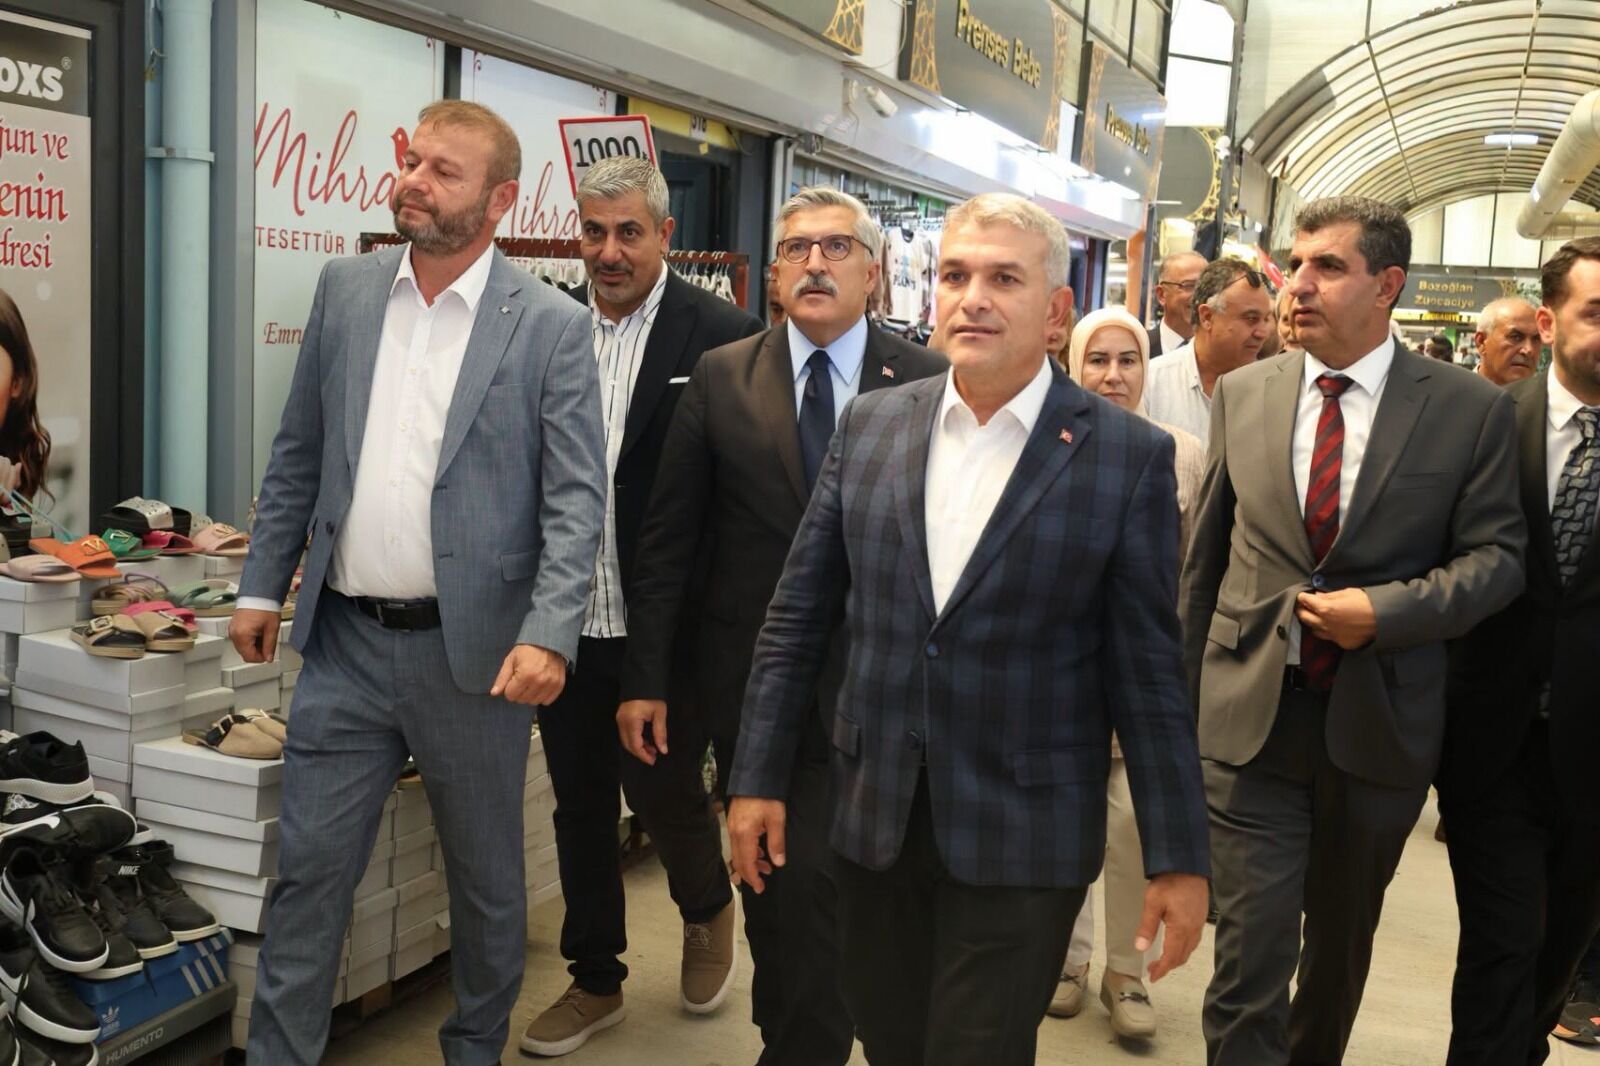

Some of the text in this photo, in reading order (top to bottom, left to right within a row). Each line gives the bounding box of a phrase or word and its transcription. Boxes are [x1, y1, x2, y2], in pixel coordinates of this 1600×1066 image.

[955, 0, 1041, 89] Prenses Bebe
[42, 133, 68, 160] ve
[255, 227, 345, 255] TESETTÜR
[118, 865, 141, 875] NIKE
